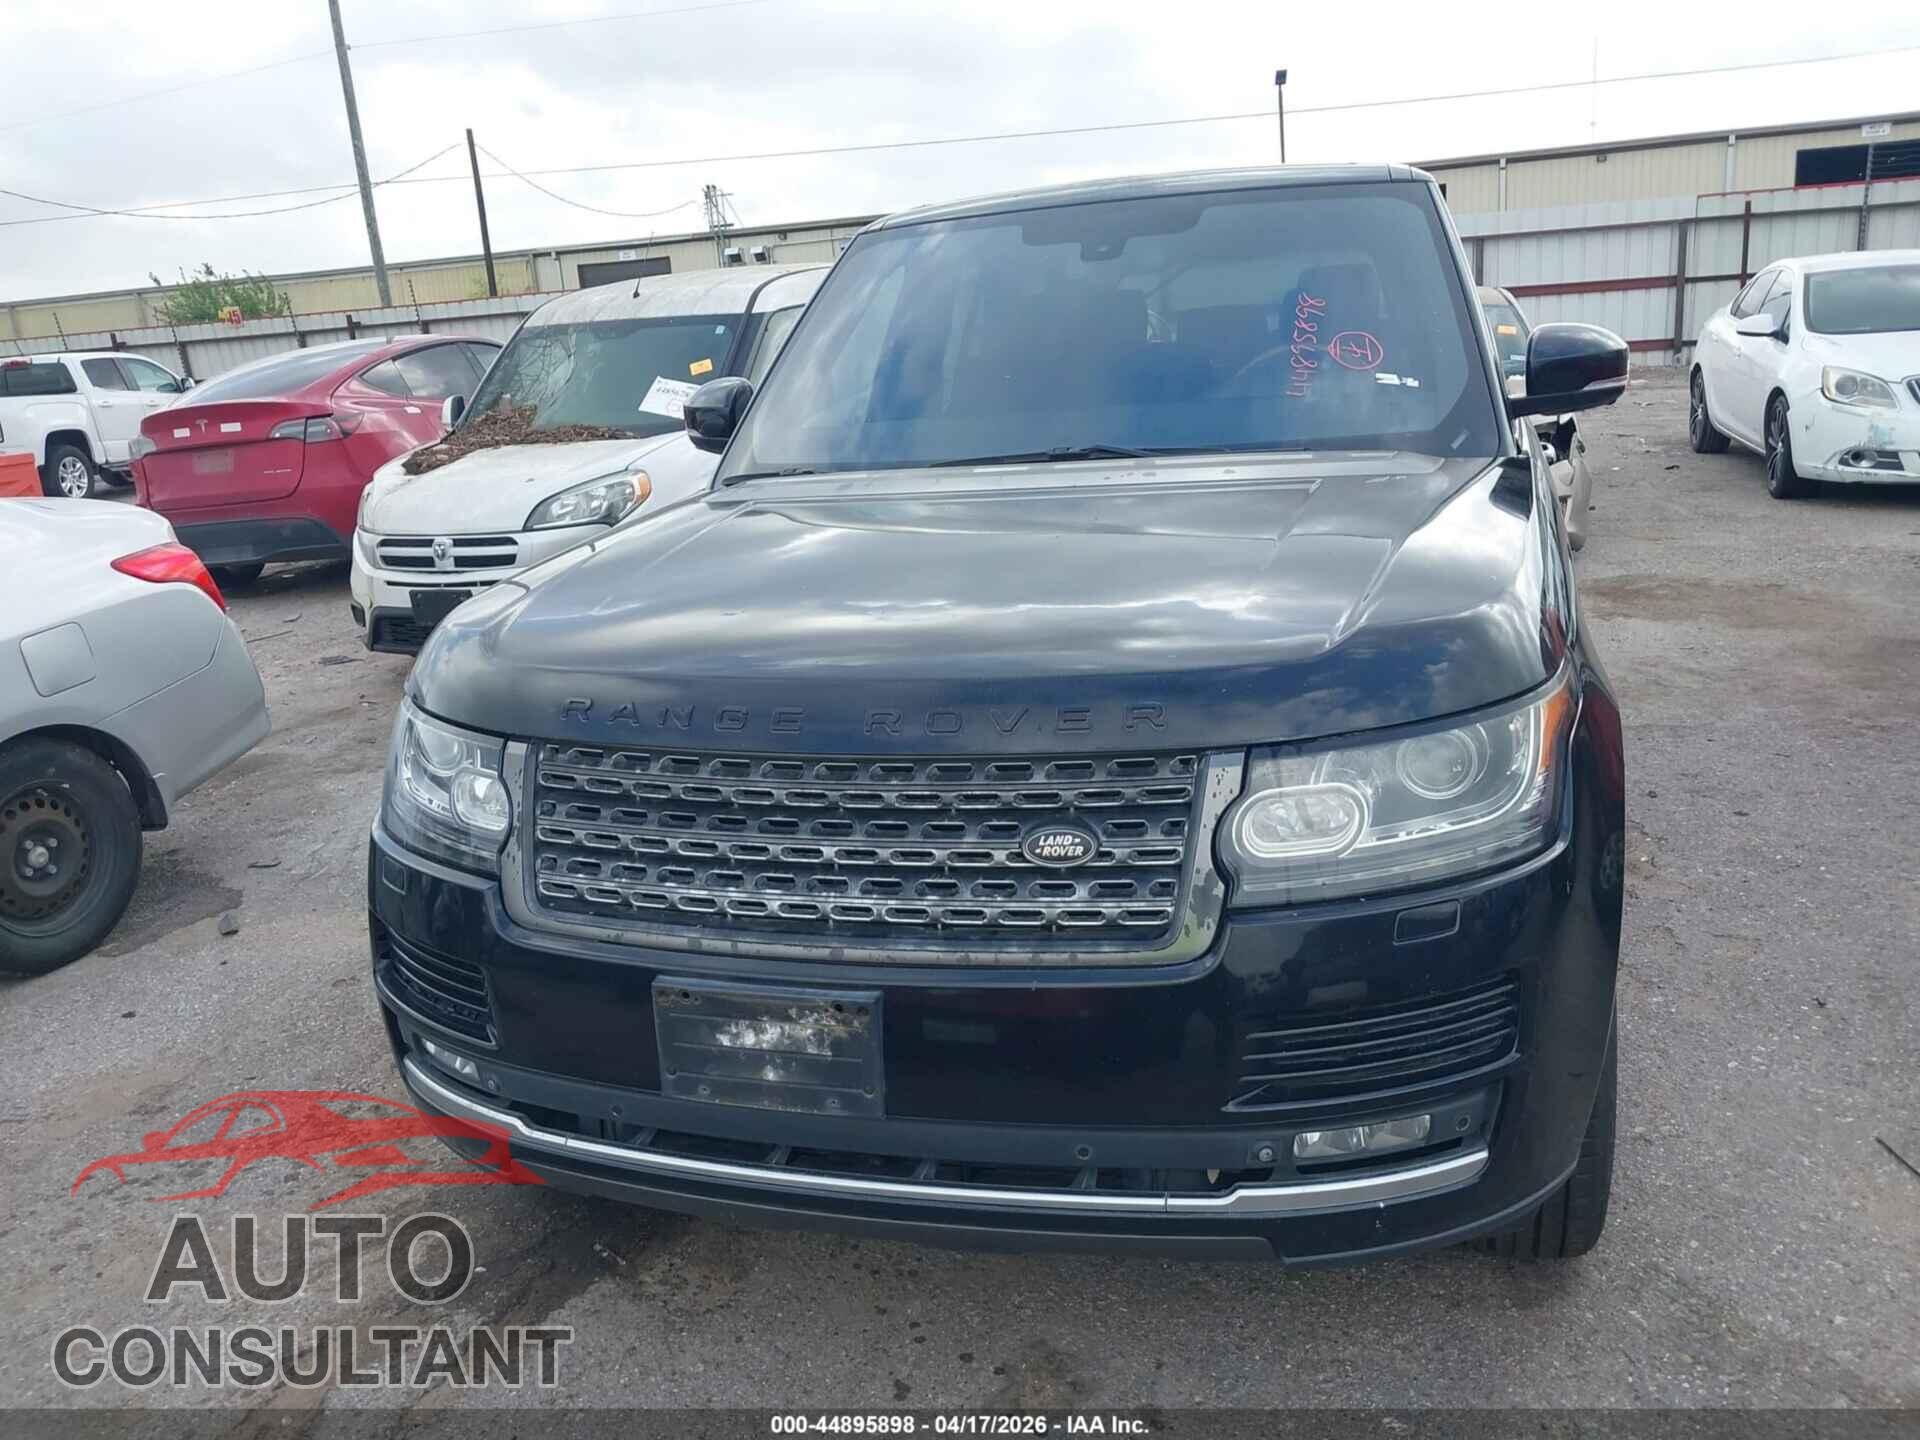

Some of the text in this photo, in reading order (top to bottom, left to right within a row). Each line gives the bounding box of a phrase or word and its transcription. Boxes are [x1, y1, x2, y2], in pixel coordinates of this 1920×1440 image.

[1286, 291, 1326, 396] 44895898
[559, 697, 1168, 735] RANGE ROVER
[1038, 835, 1073, 846] LAND
[1042, 846, 1084, 857] ROVER
